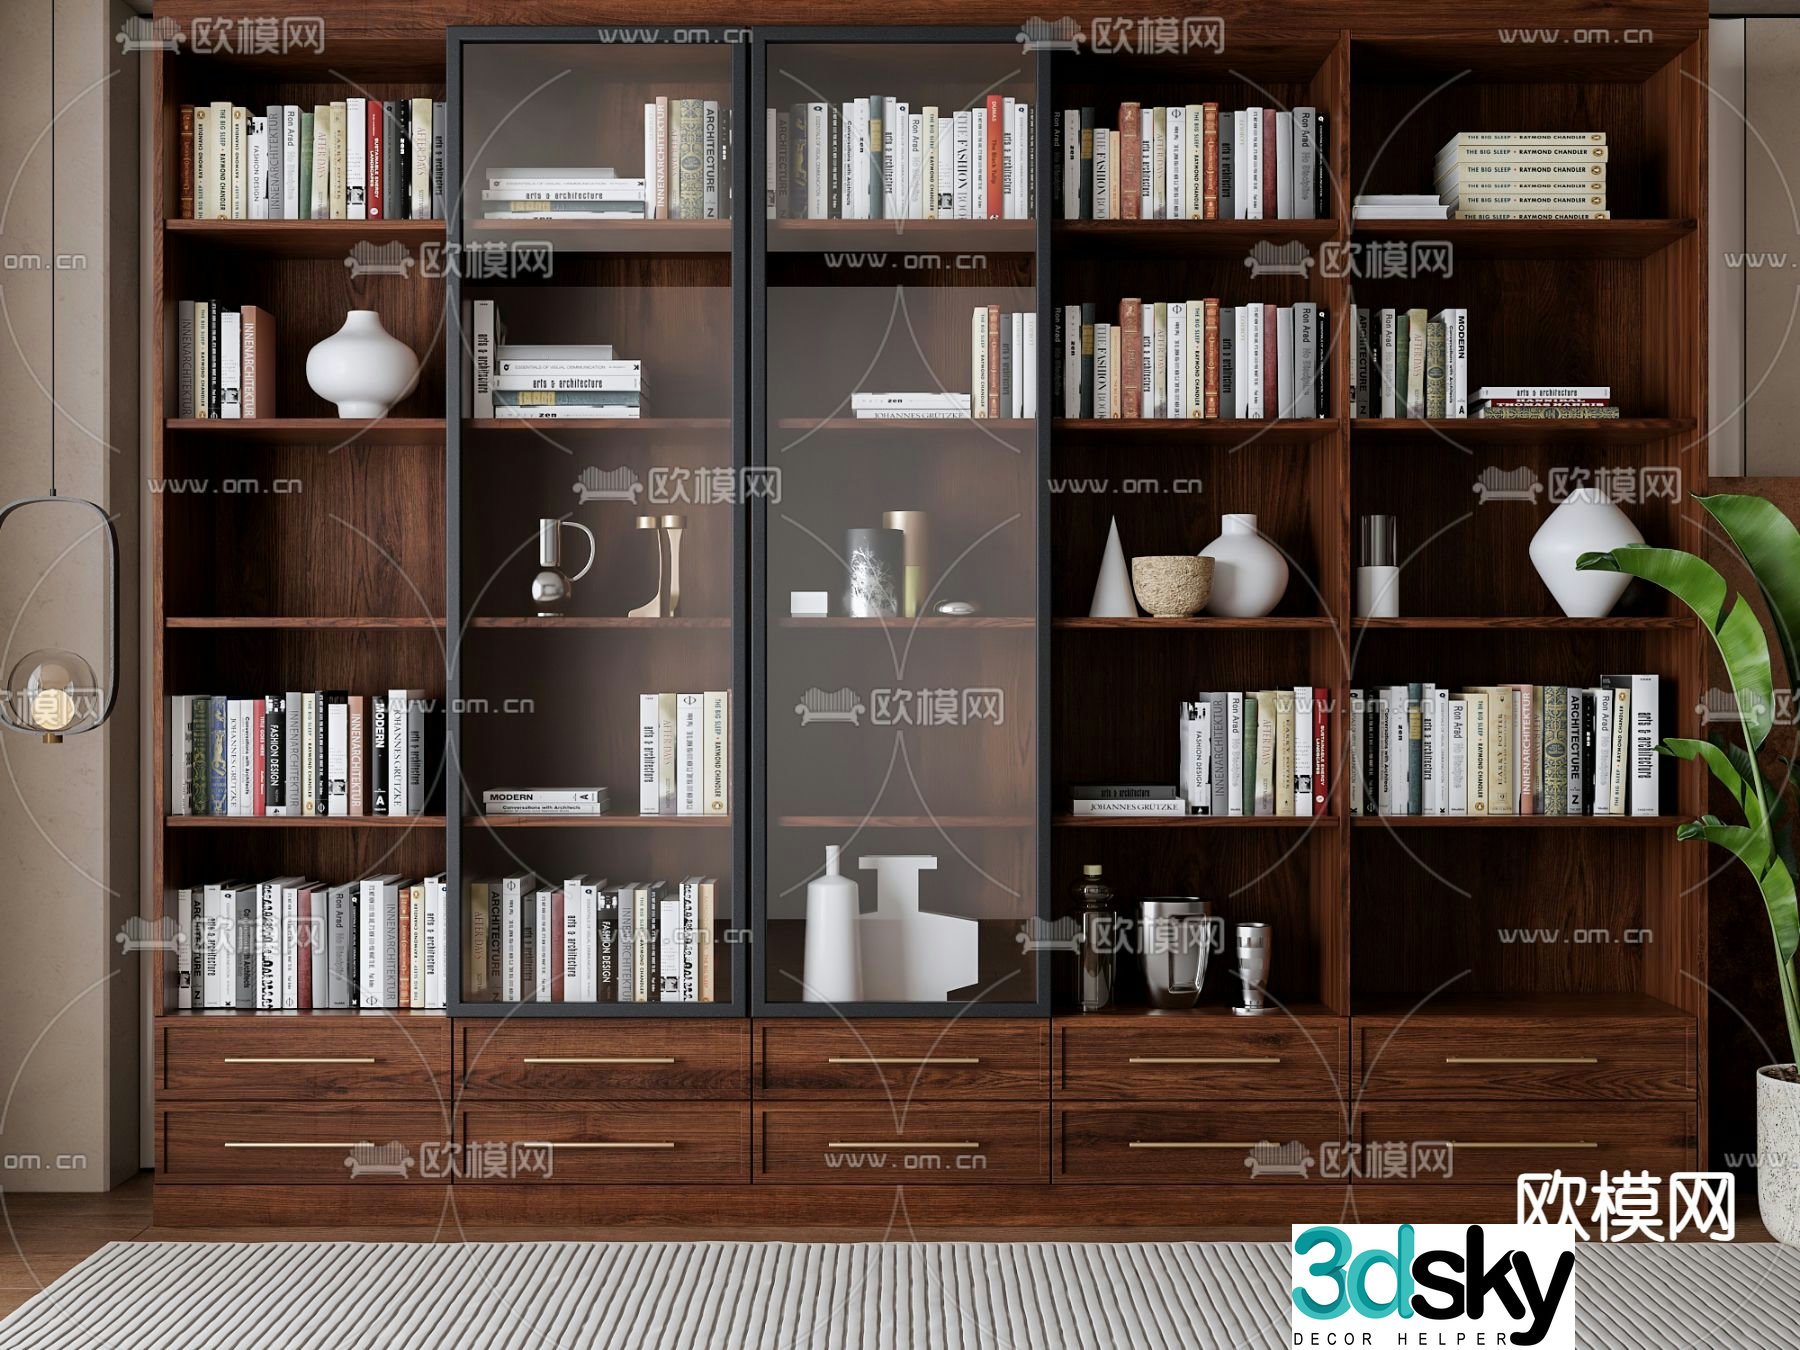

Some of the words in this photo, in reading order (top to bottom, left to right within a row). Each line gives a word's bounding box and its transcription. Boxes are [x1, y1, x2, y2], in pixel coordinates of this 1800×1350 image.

[287, 111, 295, 127] Ron
[912, 119, 920, 133] Ron
[1302, 112, 1310, 128] Ron
[287, 129, 295, 147] Arad
[912, 136, 920, 152] Arad
[1302, 130, 1310, 148] Arad
[269, 113, 280, 210] INNENARCHITEKTUR
[656, 105, 665, 208] INNENARCHITEKTUR
[706, 108, 715, 193] ARCHITECTURE
[1004, 155, 1012, 195] architecture
[1143, 161, 1151, 197] architecture
[526, 191, 541, 200] arts
[555, 191, 603, 200] architecture
[1302, 308, 1311, 323] Ron
[1143, 336, 1151, 347] arts
[1302, 325, 1311, 343] Arad
[1359, 315, 1367, 392] ARCHITECTURE
[182, 320, 192, 416] INNENARCHITEKTUR
[244, 323, 255, 416] INNENARCHITEKTUR
[1143, 357, 1151, 393] architecture
[1540, 388, 1578, 397] architecture
[1459, 405, 1464, 415] A
[714, 698, 722, 708] THE
[1232, 697, 1240, 714] Ron
[1453, 705, 1463, 720] Ron
[376, 703, 384, 748] MODERN
[714, 710, 722, 719] BIG
[1232, 715, 1240, 734] Arad
[1424, 718, 1433, 731] arts
[644, 726, 656, 738] arts
[663, 720, 672, 744] AFTER
[714, 720, 722, 735] SLEEP
[1453, 722, 1463, 739] Arad
[1571, 695, 1579, 780] ARCHITECTURE
[270, 724, 279, 757] FASHION
[1213, 700, 1224, 797] INNENARCHITEKTUR
[1522, 692, 1530, 795] INNENARCHITEKTUR
[290, 710, 299, 807] INNENARCHITEKTUR
[351, 713, 360, 807] INNENARCHITEKTUR
[644, 747, 656, 783] architecture
[663, 746, 672, 766] DAYS
[714, 741, 722, 769] RAYMOND
[1424, 741, 1433, 781] architecture
[270, 758, 279, 786] DESIGN
[714, 769, 722, 798] CHANDLER
[376, 795, 384, 806] A
[335, 893, 344, 909] Ron
[335, 910, 344, 928] Arad
[427, 913, 436, 926] arts
[567, 915, 578, 928] arts
[491, 891, 500, 977] ARCHITECTURE
[386, 903, 396, 1001] INNENARCHITEKTUR
[427, 936, 436, 975] architecture
[567, 938, 578, 977] architecture
[602, 955, 611, 983] DESIGN
